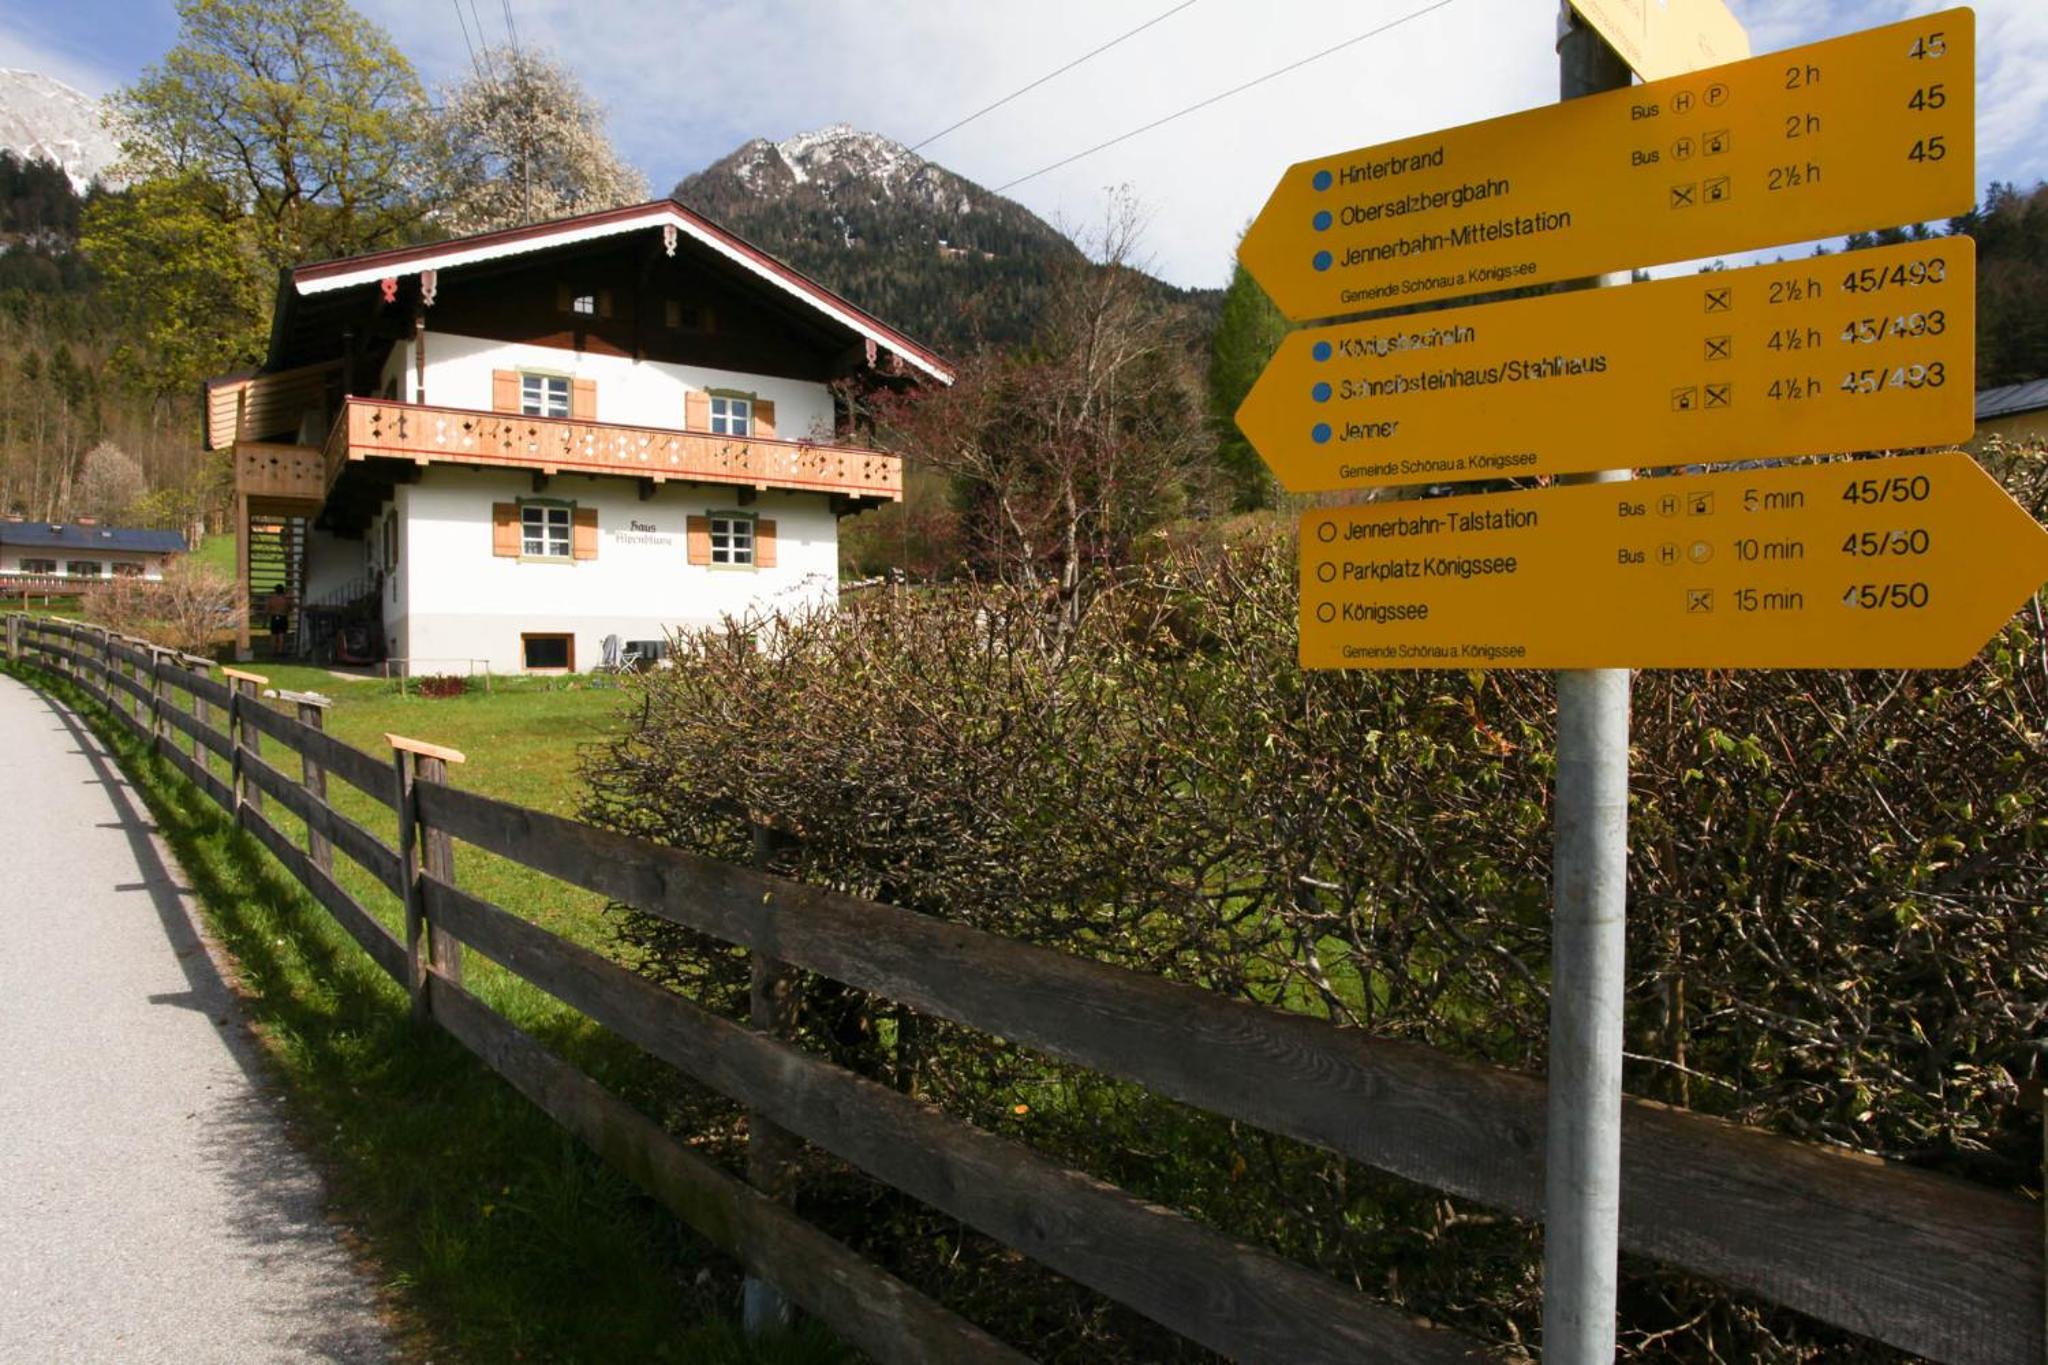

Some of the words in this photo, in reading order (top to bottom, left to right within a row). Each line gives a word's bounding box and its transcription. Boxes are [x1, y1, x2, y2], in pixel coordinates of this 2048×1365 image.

[1340, 147, 1444, 186] Hinterbrand
[1632, 104, 1659, 120] Bus
[1908, 32, 1946, 59] 45
[1340, 177, 1509, 226] Obersalzbergbahn
[1632, 151, 1659, 166] Bus
[1908, 84, 1946, 112] 45
[1340, 210, 1572, 268] Jennerbahn-Mittelstation
[1908, 136, 1946, 163] 45
[1341, 285, 1399, 303] Gemeinde
[1402, 276, 1454, 295] Schönau
[1469, 262, 1537, 283] Königssee
[1842, 258, 1945, 293] 45/493
[1841, 310, 1945, 344] 45/493
[1340, 420, 1398, 442] Jenner
[1841, 362, 1945, 394] 45/493
[1340, 463, 1398, 479] Gemeinde
[1401, 458, 1455, 475] Schönau
[1469, 452, 1537, 469] Königssee
[1344, 509, 1537, 540] Jennerbahn-Talstation
[1619, 502, 1645, 517] Bus
[1842, 476, 1930, 504] 45/50
[1343, 560, 1420, 582] Parkplatz
[1424, 555, 1517, 578] Königssee
[1618, 549, 1645, 564] Bus
[1734, 539, 1758, 561] 10
[1765, 539, 1803, 559] min
[1842, 529, 1930, 557] 45/50
[1342, 602, 1428, 624] Königssee
[1734, 590, 1758, 611] 15
[1764, 590, 1803, 609] min
[1842, 582, 1929, 609] 45/50
[1343, 645, 1396, 658] Gemeinde
[1400, 644, 1450, 658] Schönau
[1462, 644, 1526, 660] Königssee
